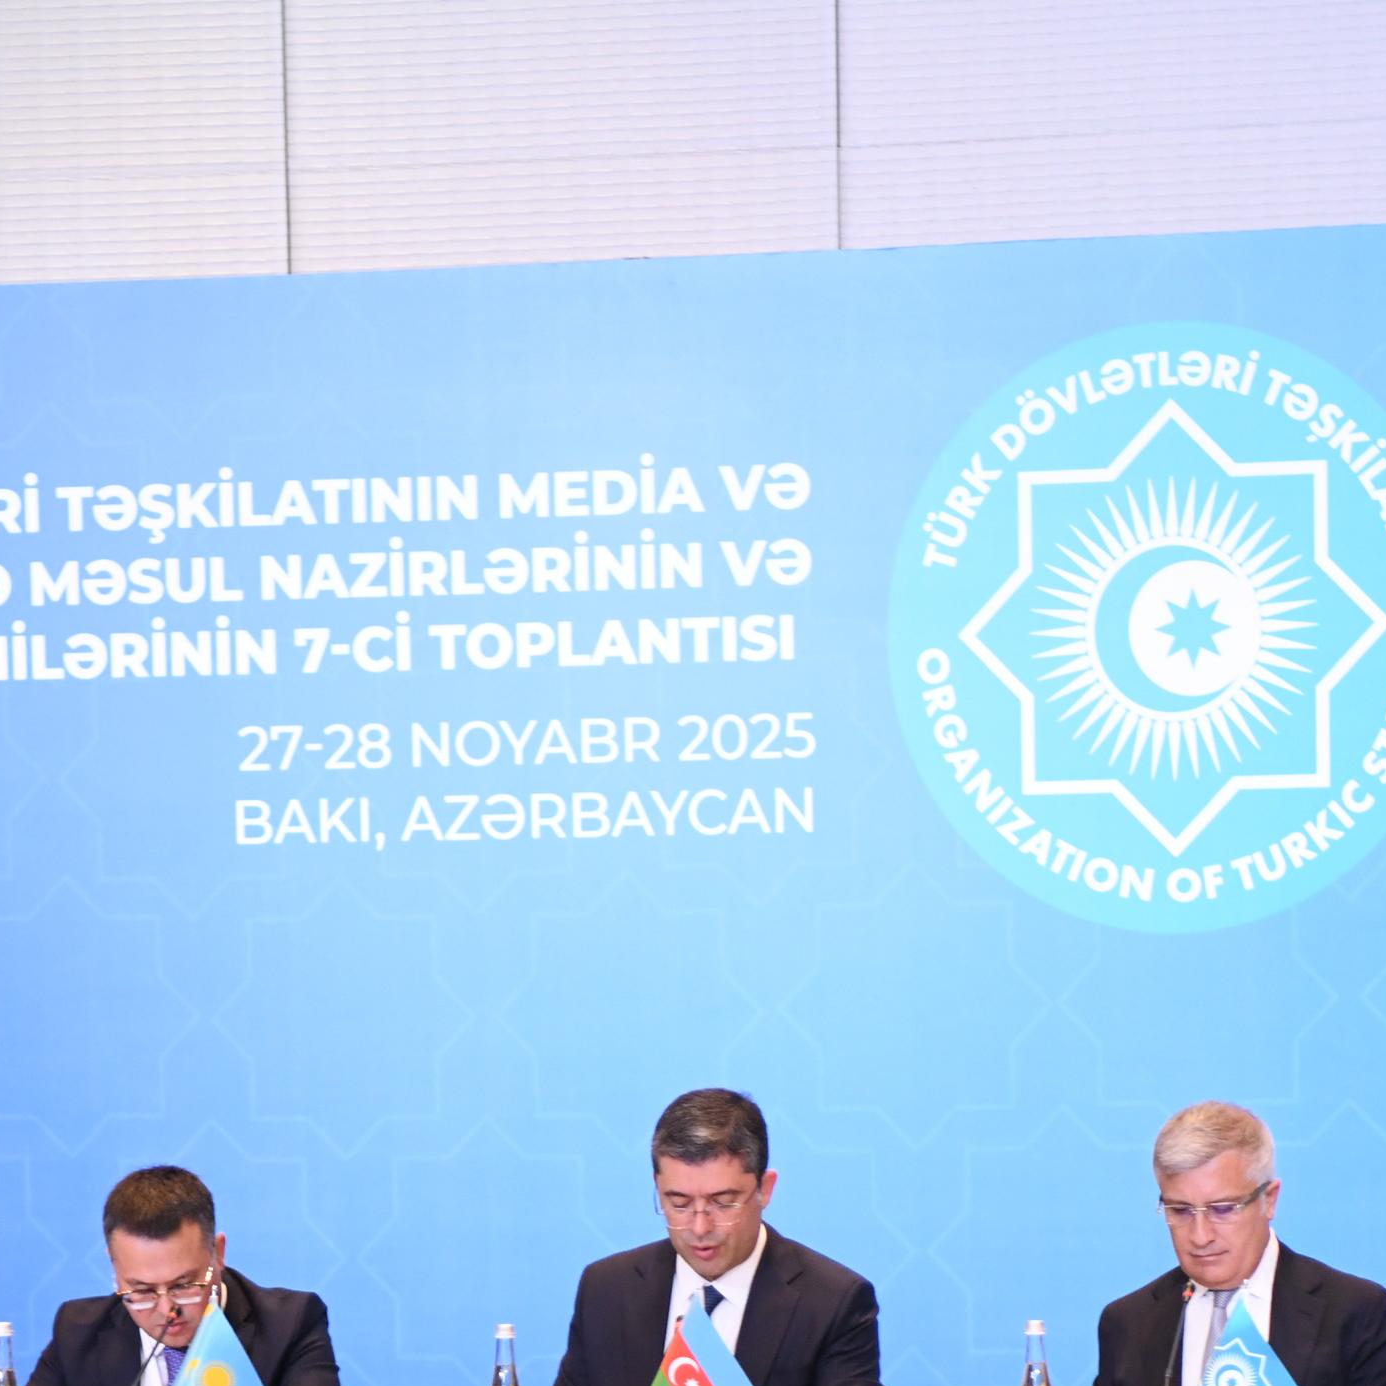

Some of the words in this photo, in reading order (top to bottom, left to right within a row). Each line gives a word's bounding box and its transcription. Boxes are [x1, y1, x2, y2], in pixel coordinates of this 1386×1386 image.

[922, 452, 1003, 570] TÜRK
[989, 349, 1261, 461] DÖVLƏTLƏRİ
[57, 468, 478, 544] TƏŞKİLATININ
[500, 453, 704, 518] MEDİA
[719, 463, 810, 511] VƏ
[31, 557, 243, 606] MƏSUL
[261, 529, 702, 600] NAZİRLƏRİNİN
[721, 538, 812, 586] VƏ
[295, 611, 411, 673] 7-Cİ
[429, 615, 794, 669] TOPLANTISI
[239, 723, 391, 771] 27-28
[412, 717, 660, 767] NOYABR
[678, 712, 816, 761] 2025
[916, 647, 1154, 901] ORGANIZATION
[1165, 864, 1224, 903] OF
[1230, 779, 1376, 891] TURKIC
[236, 797, 385, 850] BAKI,
[402, 787, 813, 841] AZƏRBAYCAN
